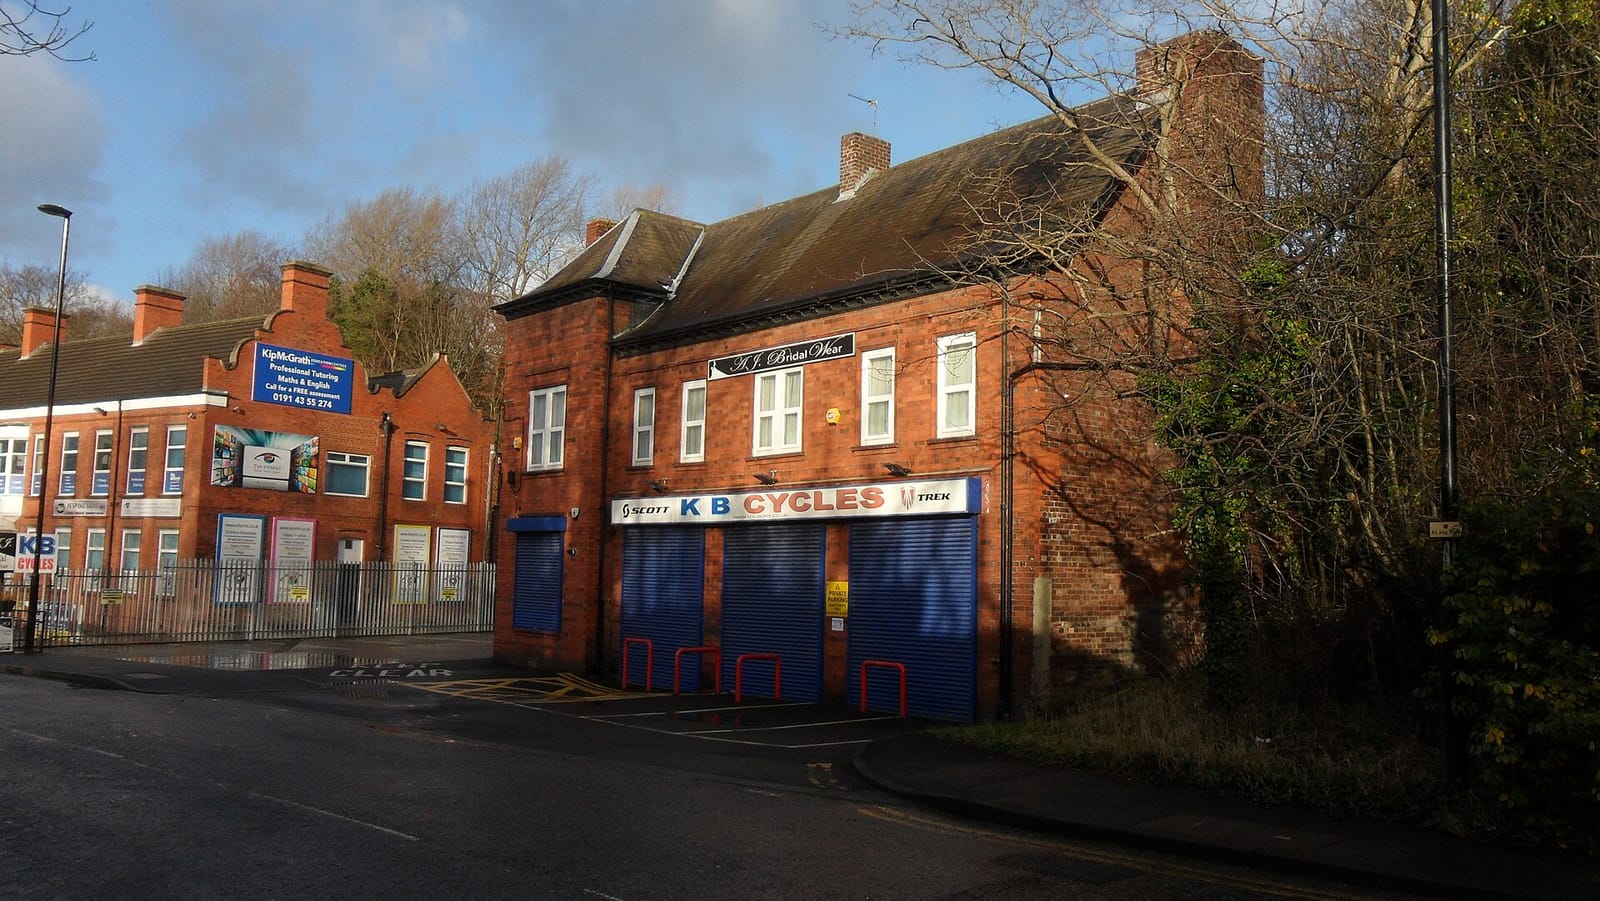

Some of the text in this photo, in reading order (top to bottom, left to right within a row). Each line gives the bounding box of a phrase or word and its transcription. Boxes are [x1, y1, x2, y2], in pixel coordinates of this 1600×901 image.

[767, 348, 808, 364] Bridal
[808, 336, 845, 358] Wear
[270, 363, 338, 382] Professional Tutoring
[278, 375, 298, 385] Maths
[307, 380, 330, 390] English
[273, 393, 332, 408] 0191 43 55 274
[293, 387, 308, 395] FREE
[310, 391, 340, 400] assessment
[631, 487, 950, 516] SCOTT K B CYCLES TREK
[18, 557, 54, 570] CYCES
[329, 669, 456, 677] CLEAR
